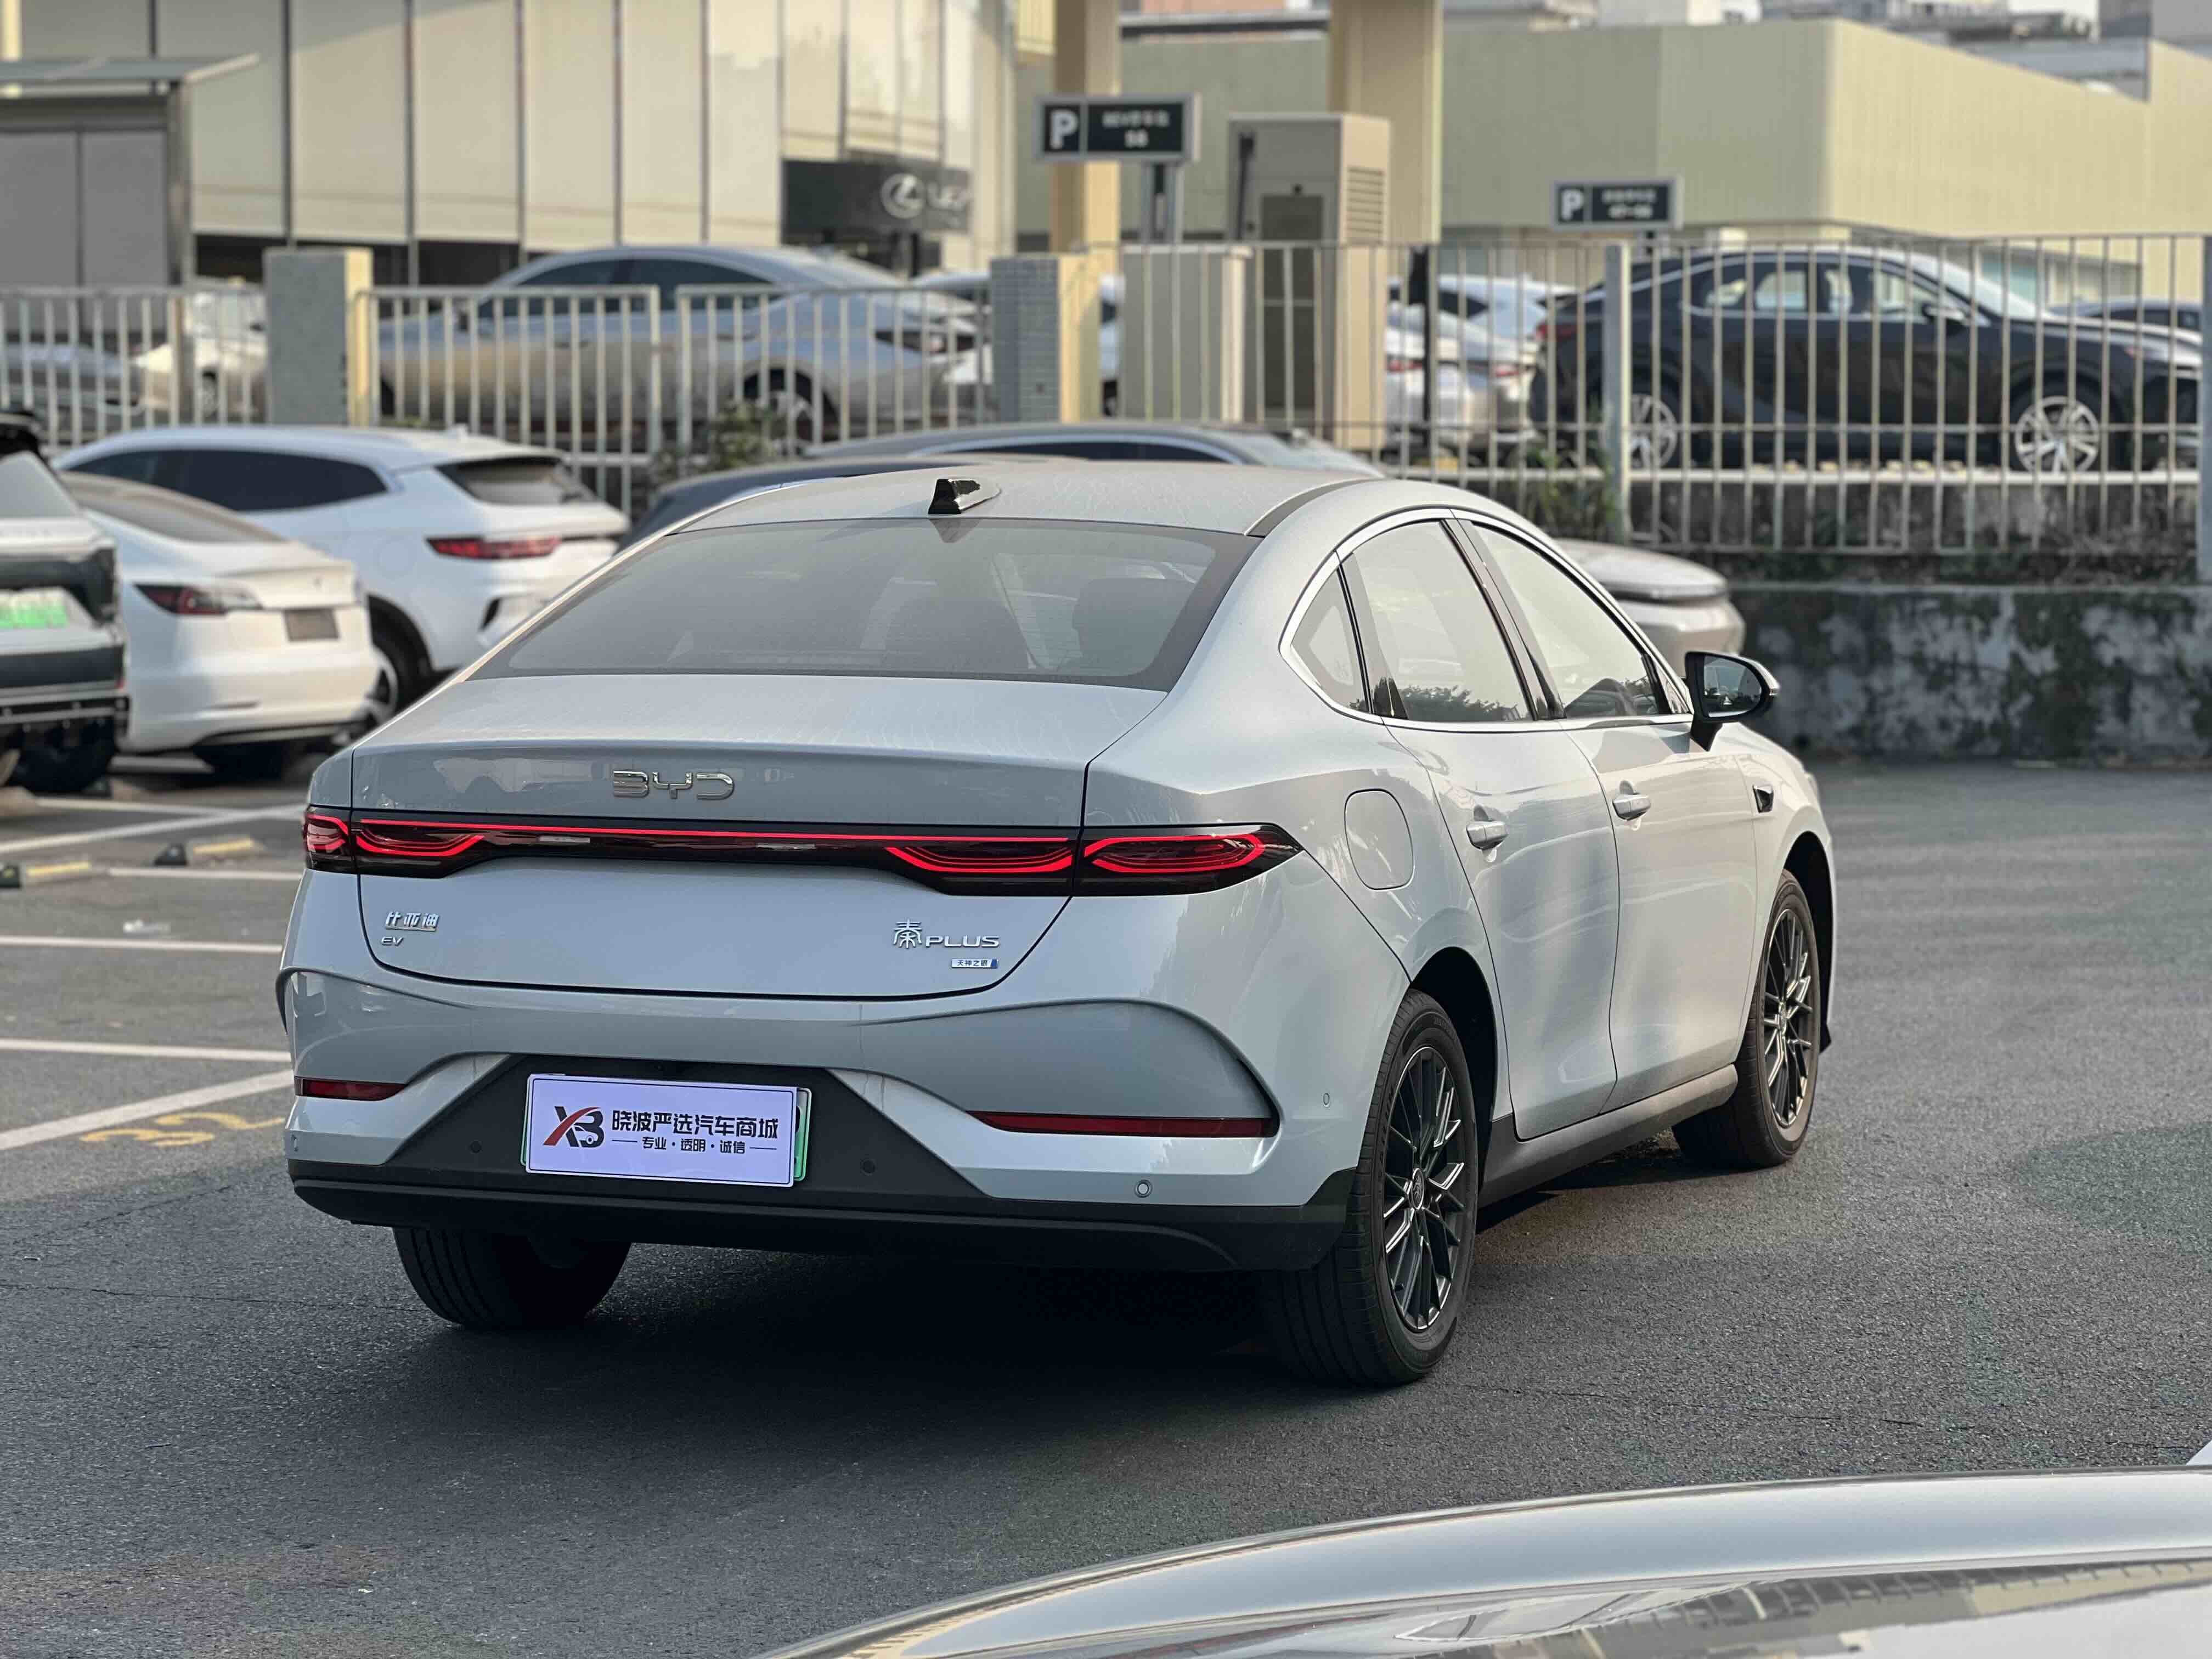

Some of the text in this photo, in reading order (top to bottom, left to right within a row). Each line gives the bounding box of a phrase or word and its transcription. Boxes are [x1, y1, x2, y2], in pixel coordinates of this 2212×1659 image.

[1050, 110, 1079, 149] P
[1562, 189, 1584, 220] P
[613, 770, 735, 799] BYD
[381, 936, 404, 946] EV
[612, 1110, 778, 1139] 晓波严选汽车商城
